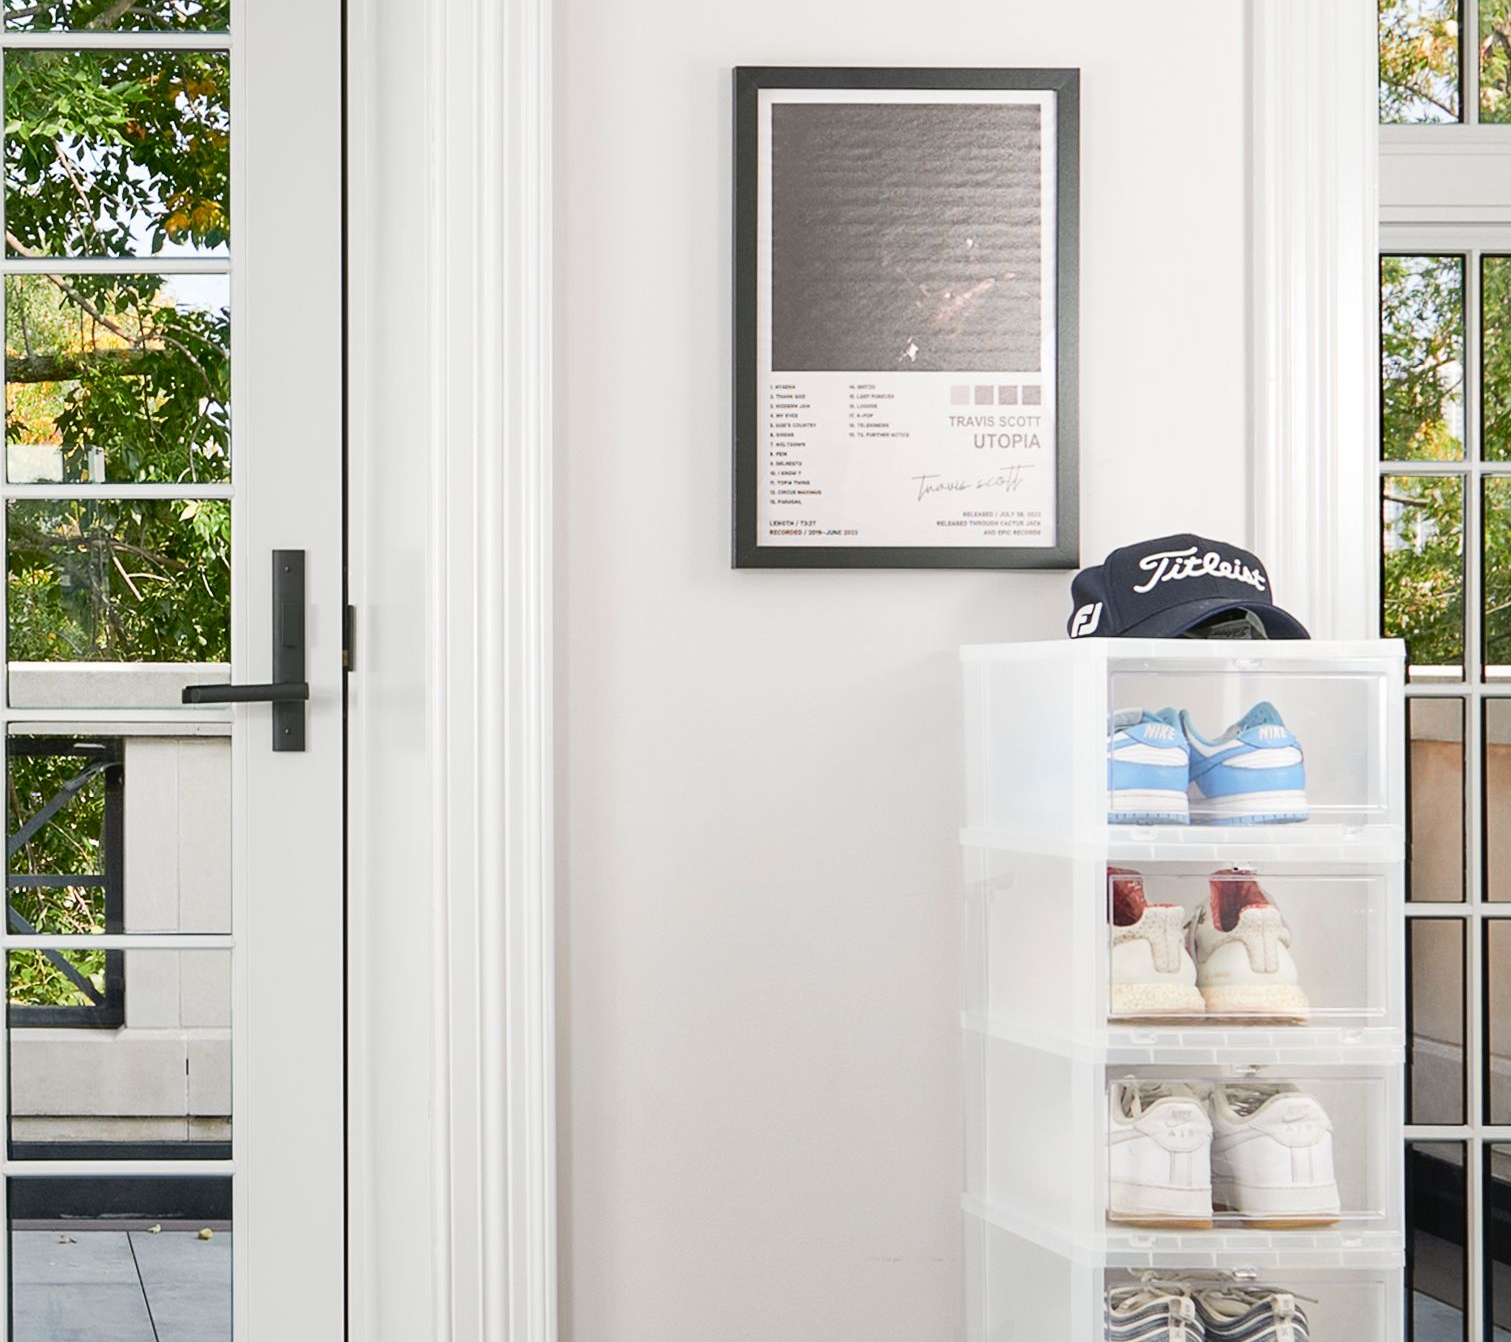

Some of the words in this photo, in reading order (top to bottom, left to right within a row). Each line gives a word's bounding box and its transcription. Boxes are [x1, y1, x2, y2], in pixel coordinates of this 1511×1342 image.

[949, 416, 995, 427] TRAVIS
[999, 416, 1041, 427] SCOTT
[974, 433, 1041, 449] UTOPIA
[1133, 546, 1266, 594] Titleist
[1071, 602, 1103, 638] FJ
[1143, 725, 1177, 740] NIKE
[1258, 727, 1287, 740] NIKE
